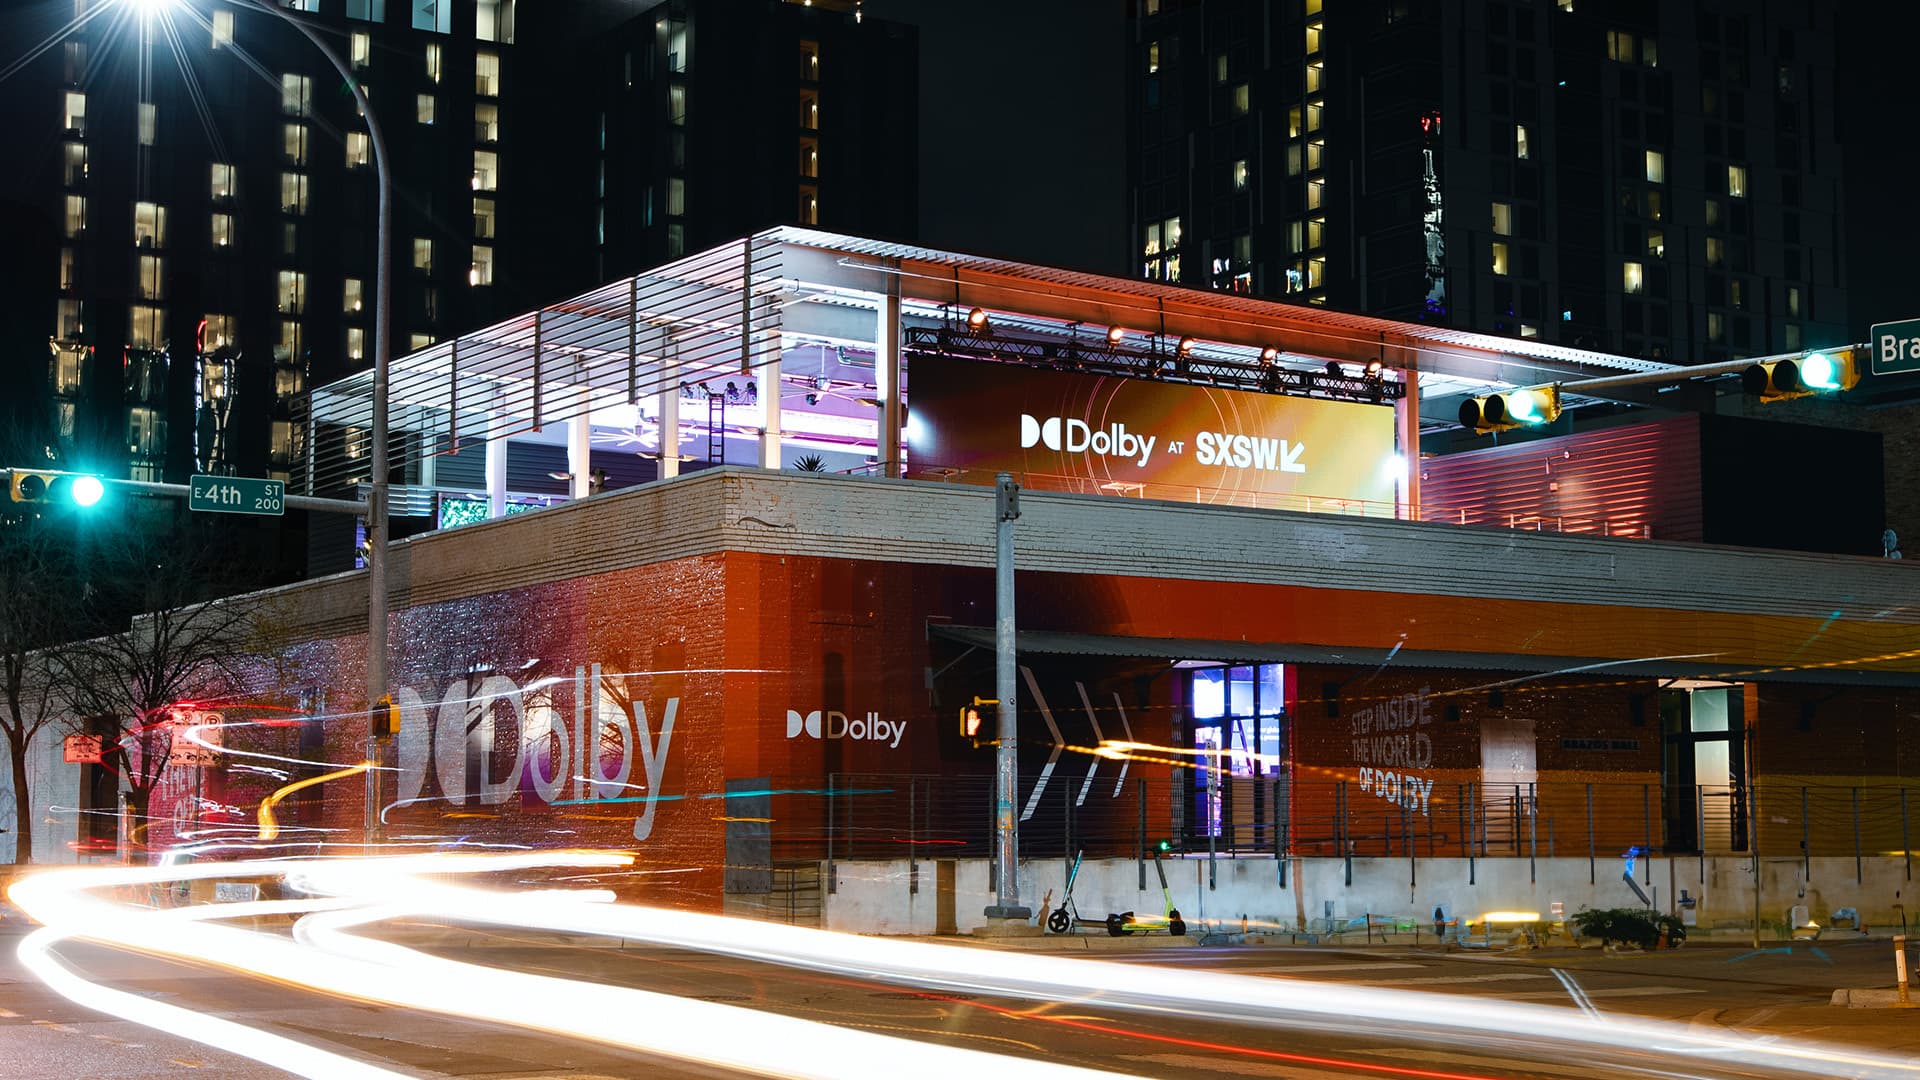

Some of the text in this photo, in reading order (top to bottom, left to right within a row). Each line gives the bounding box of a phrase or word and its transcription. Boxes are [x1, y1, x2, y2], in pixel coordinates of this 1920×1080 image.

[1067, 418, 1156, 467] Dolby
[1168, 441, 1184, 454] AT
[194, 484, 280, 505] E 4th ST
[255, 498, 280, 510] 200
[827, 710, 907, 749] Dolby
[1352, 685, 1432, 735] STEP INSIDE
[480, 663, 680, 841] Dolby
[1352, 731, 1432, 769] THE WORLD
[1360, 767, 1434, 817] OF DOLBY
